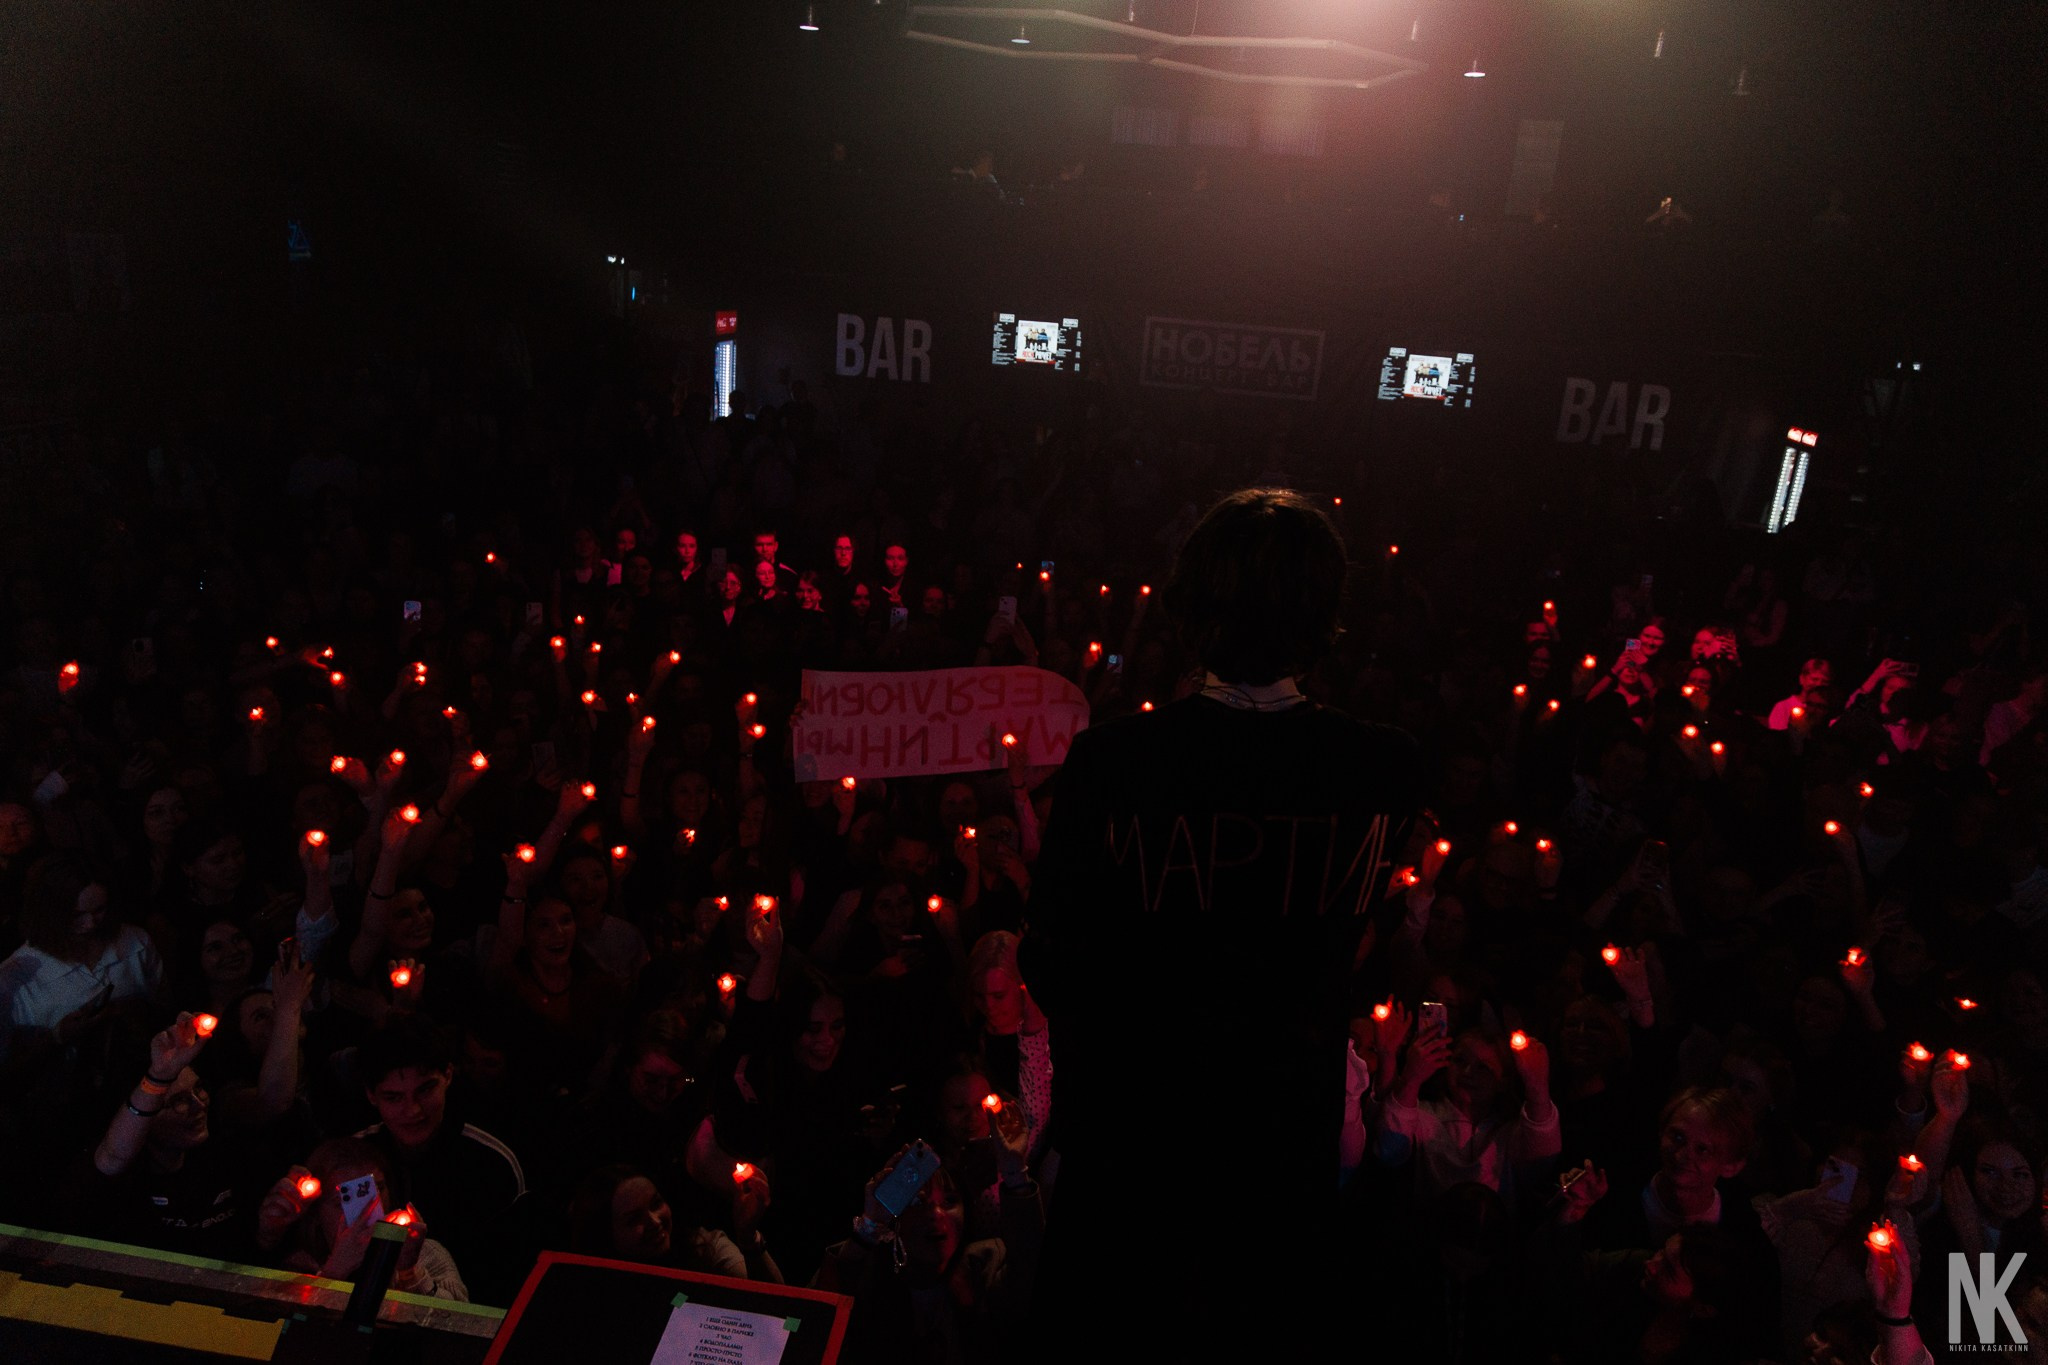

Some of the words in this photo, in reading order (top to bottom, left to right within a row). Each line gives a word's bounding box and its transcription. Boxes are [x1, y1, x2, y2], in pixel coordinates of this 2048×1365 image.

[836, 313, 932, 383] BAR
[1152, 326, 1311, 374] НОБЕЛЬ
[1556, 377, 1671, 450] BAR
[945, 672, 1083, 716] ТЕБЯ
